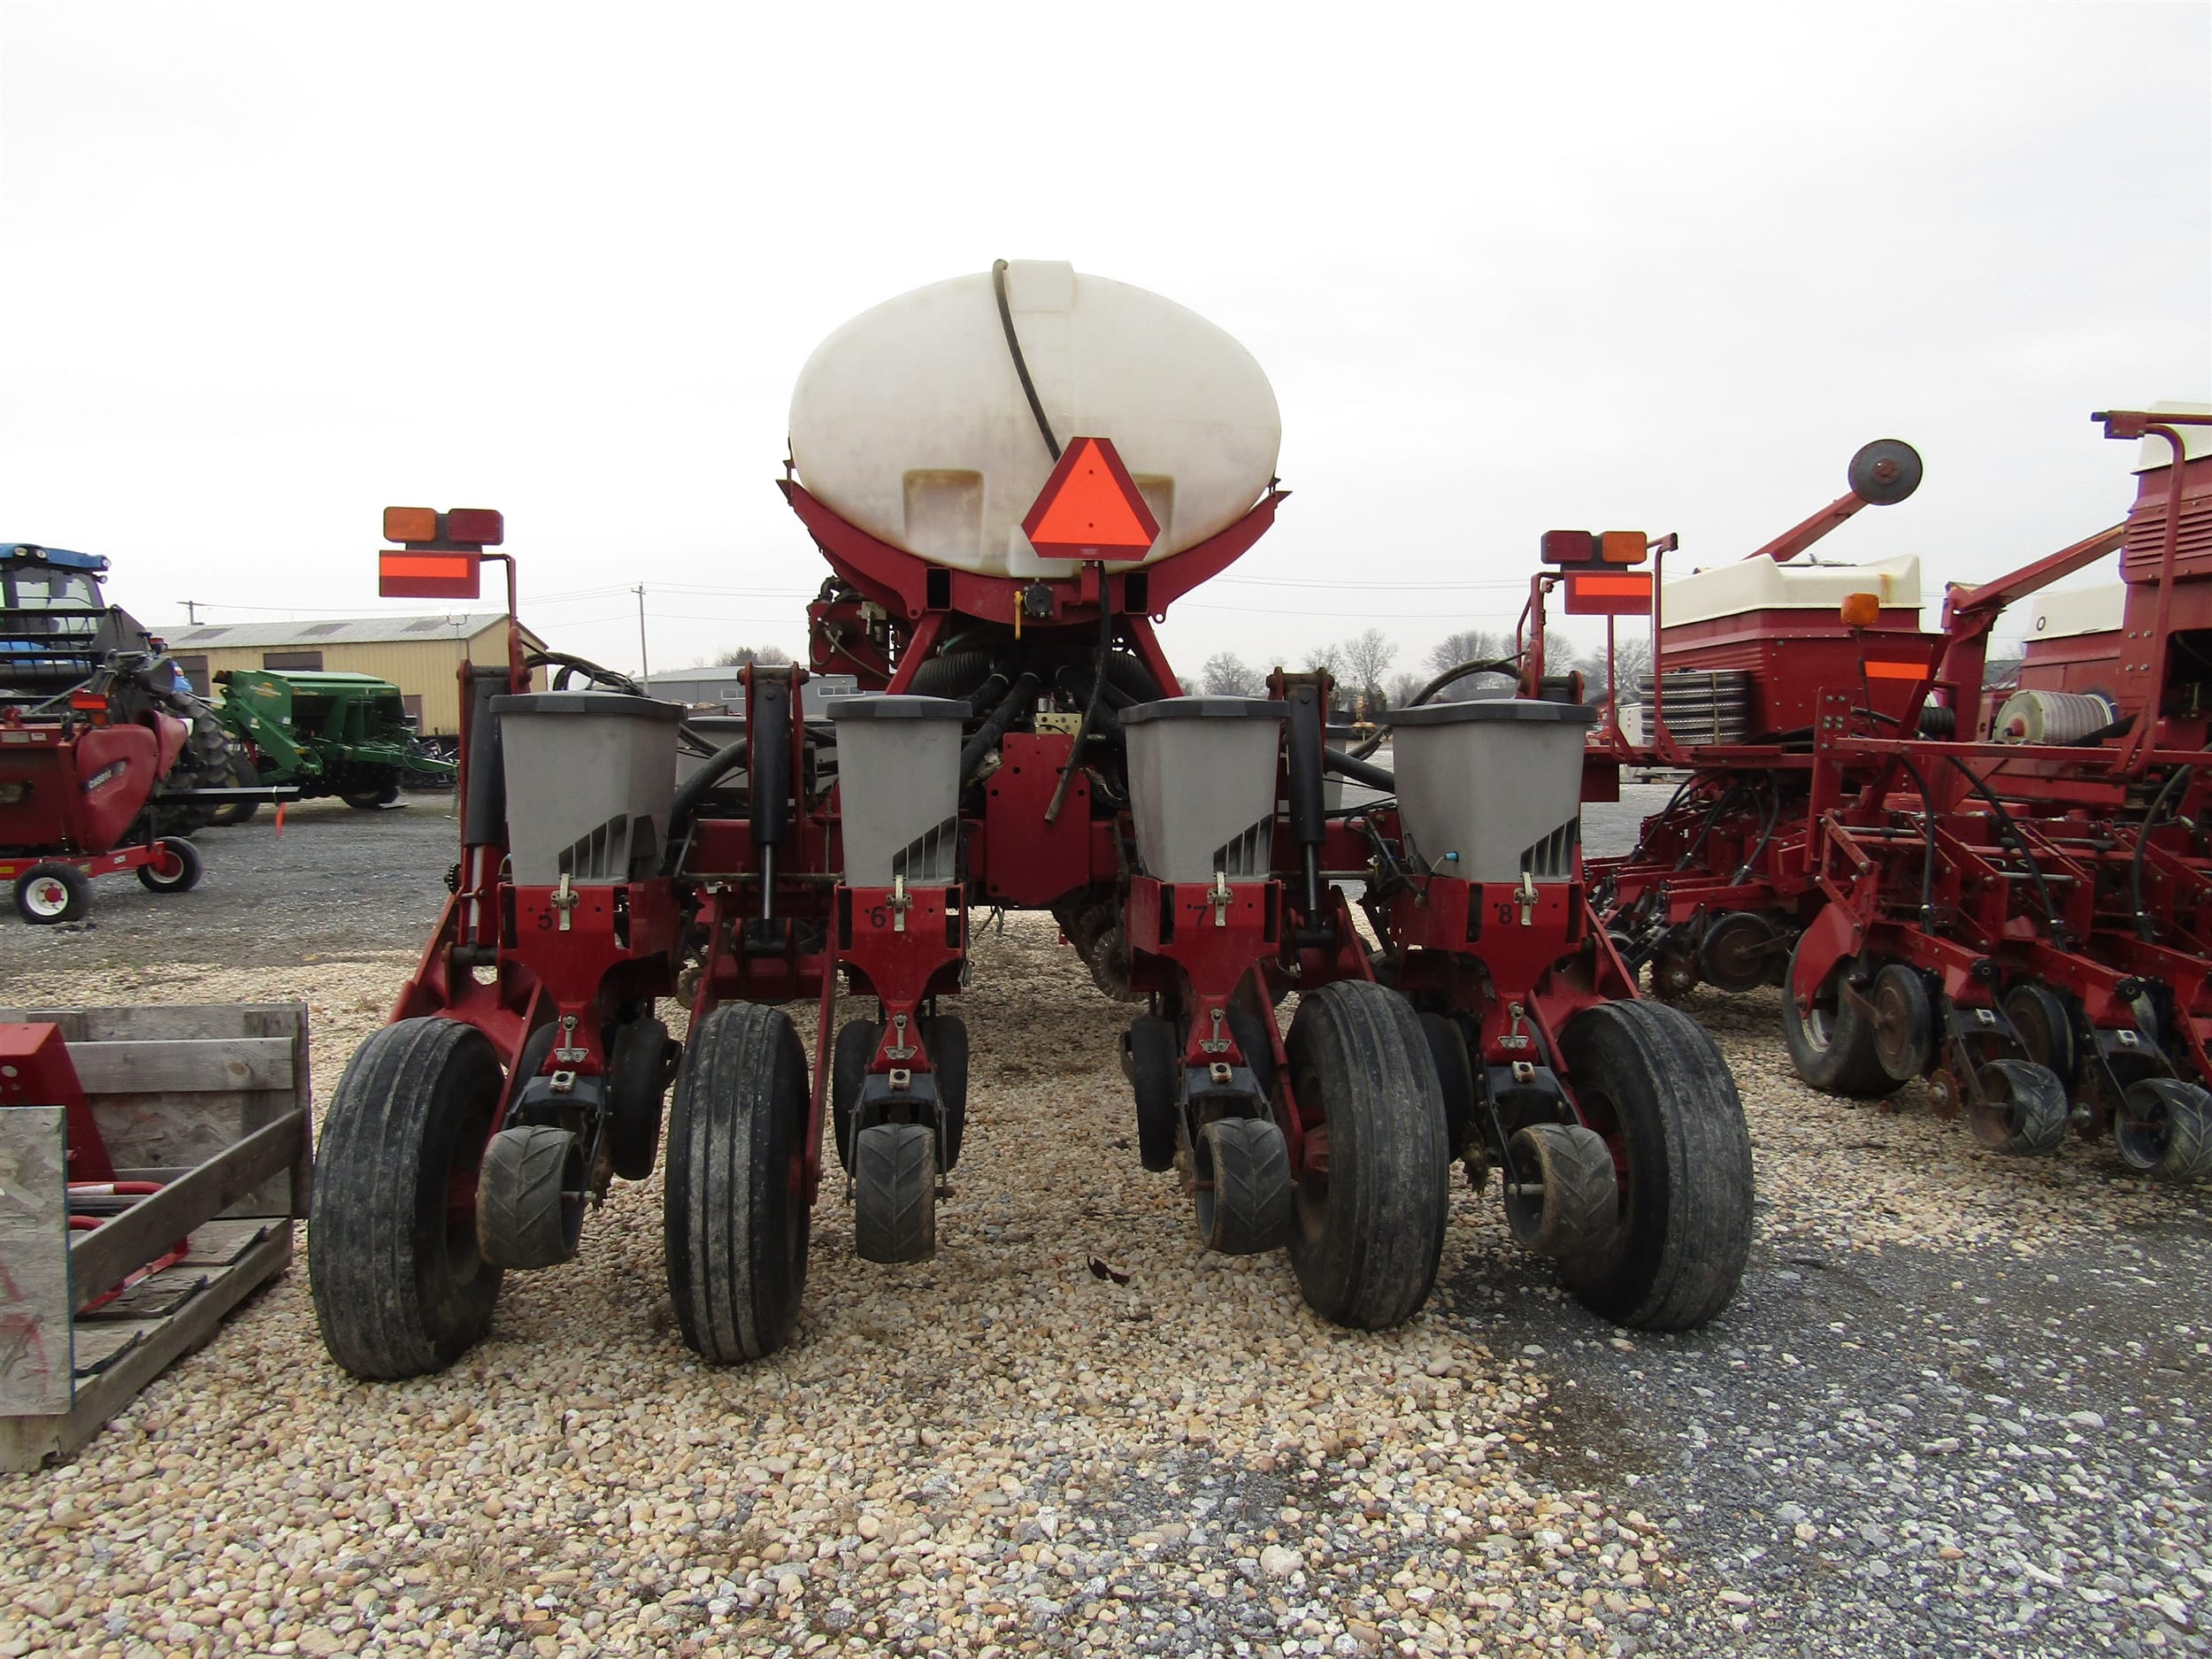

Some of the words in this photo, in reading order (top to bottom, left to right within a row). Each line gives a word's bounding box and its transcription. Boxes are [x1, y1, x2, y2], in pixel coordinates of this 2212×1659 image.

[538, 907, 553, 930] 5
[871, 906, 887, 928] 6
[1193, 905, 1208, 927] 7
[1499, 903, 1512, 926] 8
